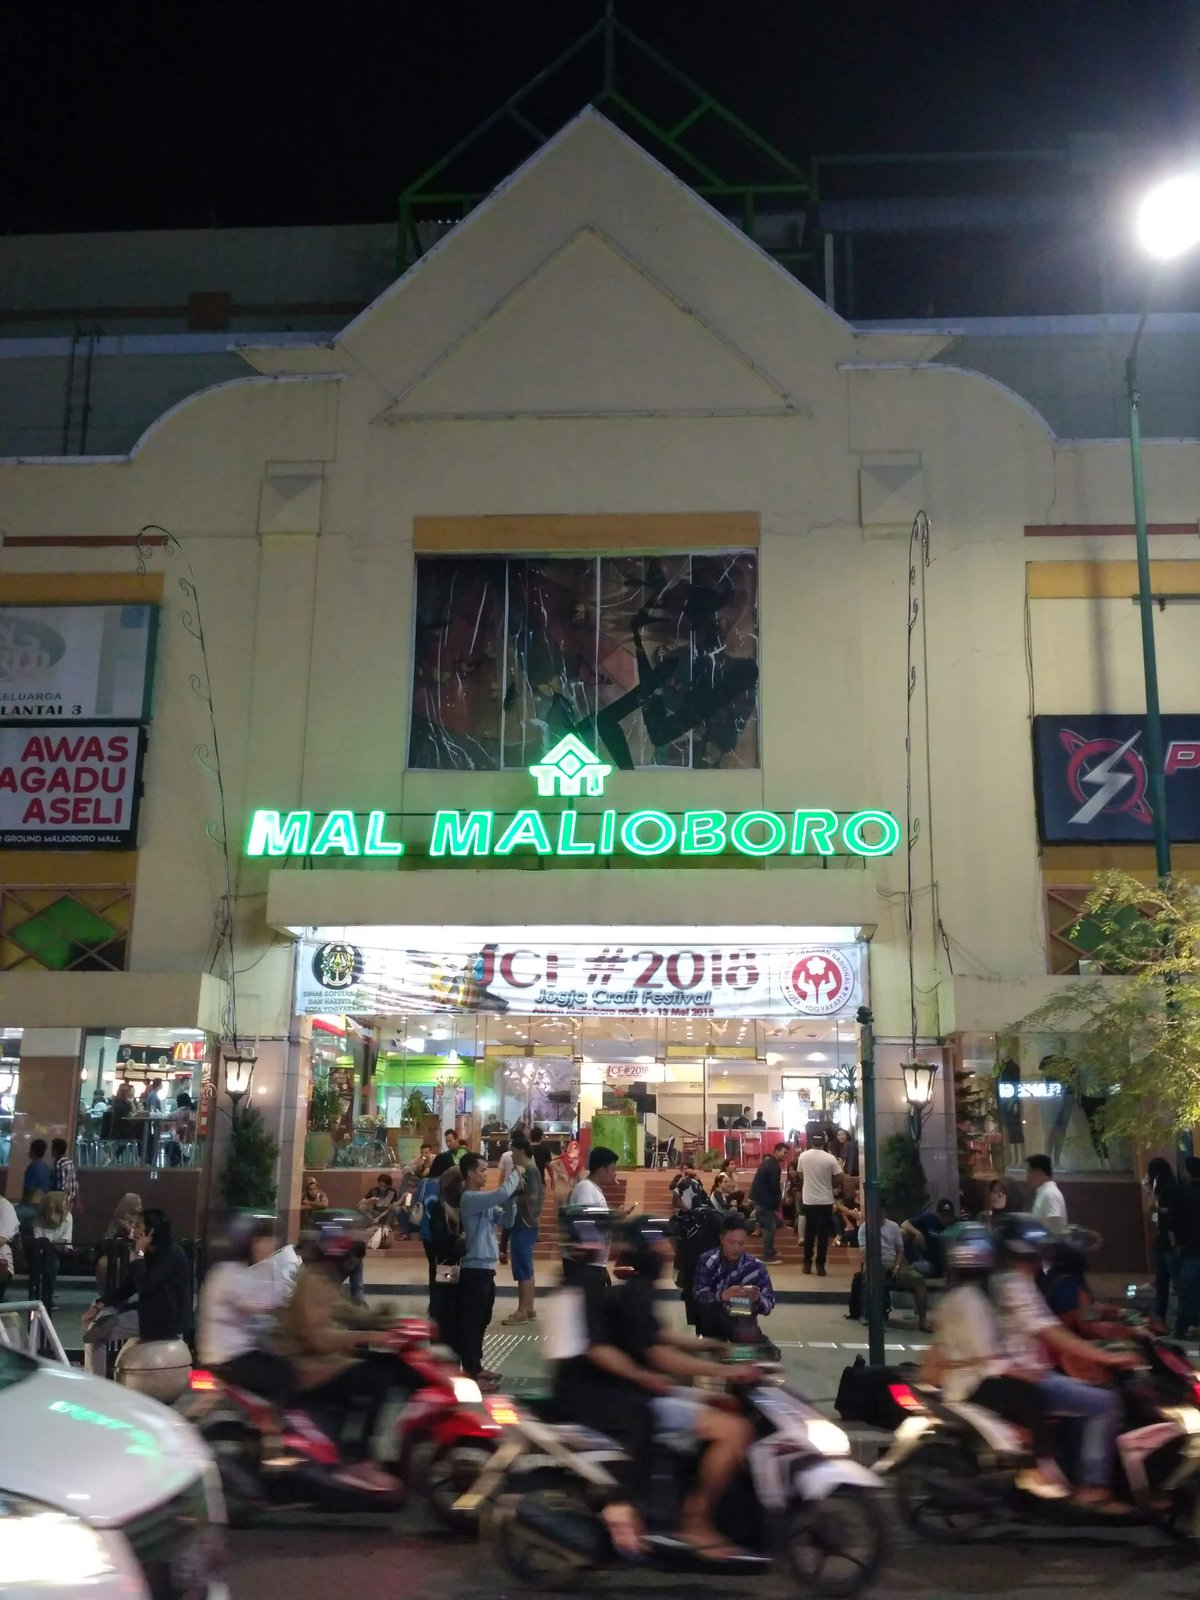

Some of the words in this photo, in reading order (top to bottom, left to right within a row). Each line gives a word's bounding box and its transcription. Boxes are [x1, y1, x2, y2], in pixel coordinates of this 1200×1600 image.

[0, 692, 62, 701] ELUARGA
[1, 705, 63, 716] LANTAI
[71, 705, 82, 715] 3
[21, 736, 129, 763] AWAS
[22, 797, 123, 824] ASELI
[4, 835, 42, 843] GROUND
[97, 835, 121, 843] MALL
[246, 808, 405, 857] MAL
[428, 807, 901, 857] MALIOBORO
[582, 948, 760, 990] #2018
[832, 953, 851, 985] NASIONAL
[535, 989, 588, 1007] Jogja
[592, 989, 639, 1004] Craft
[641, 989, 712, 1006] Festival
[805, 991, 848, 1012] YOGYAKARTA
[658, 1007, 669, 1016] 13
[691, 1007, 715, 1016] 2018
